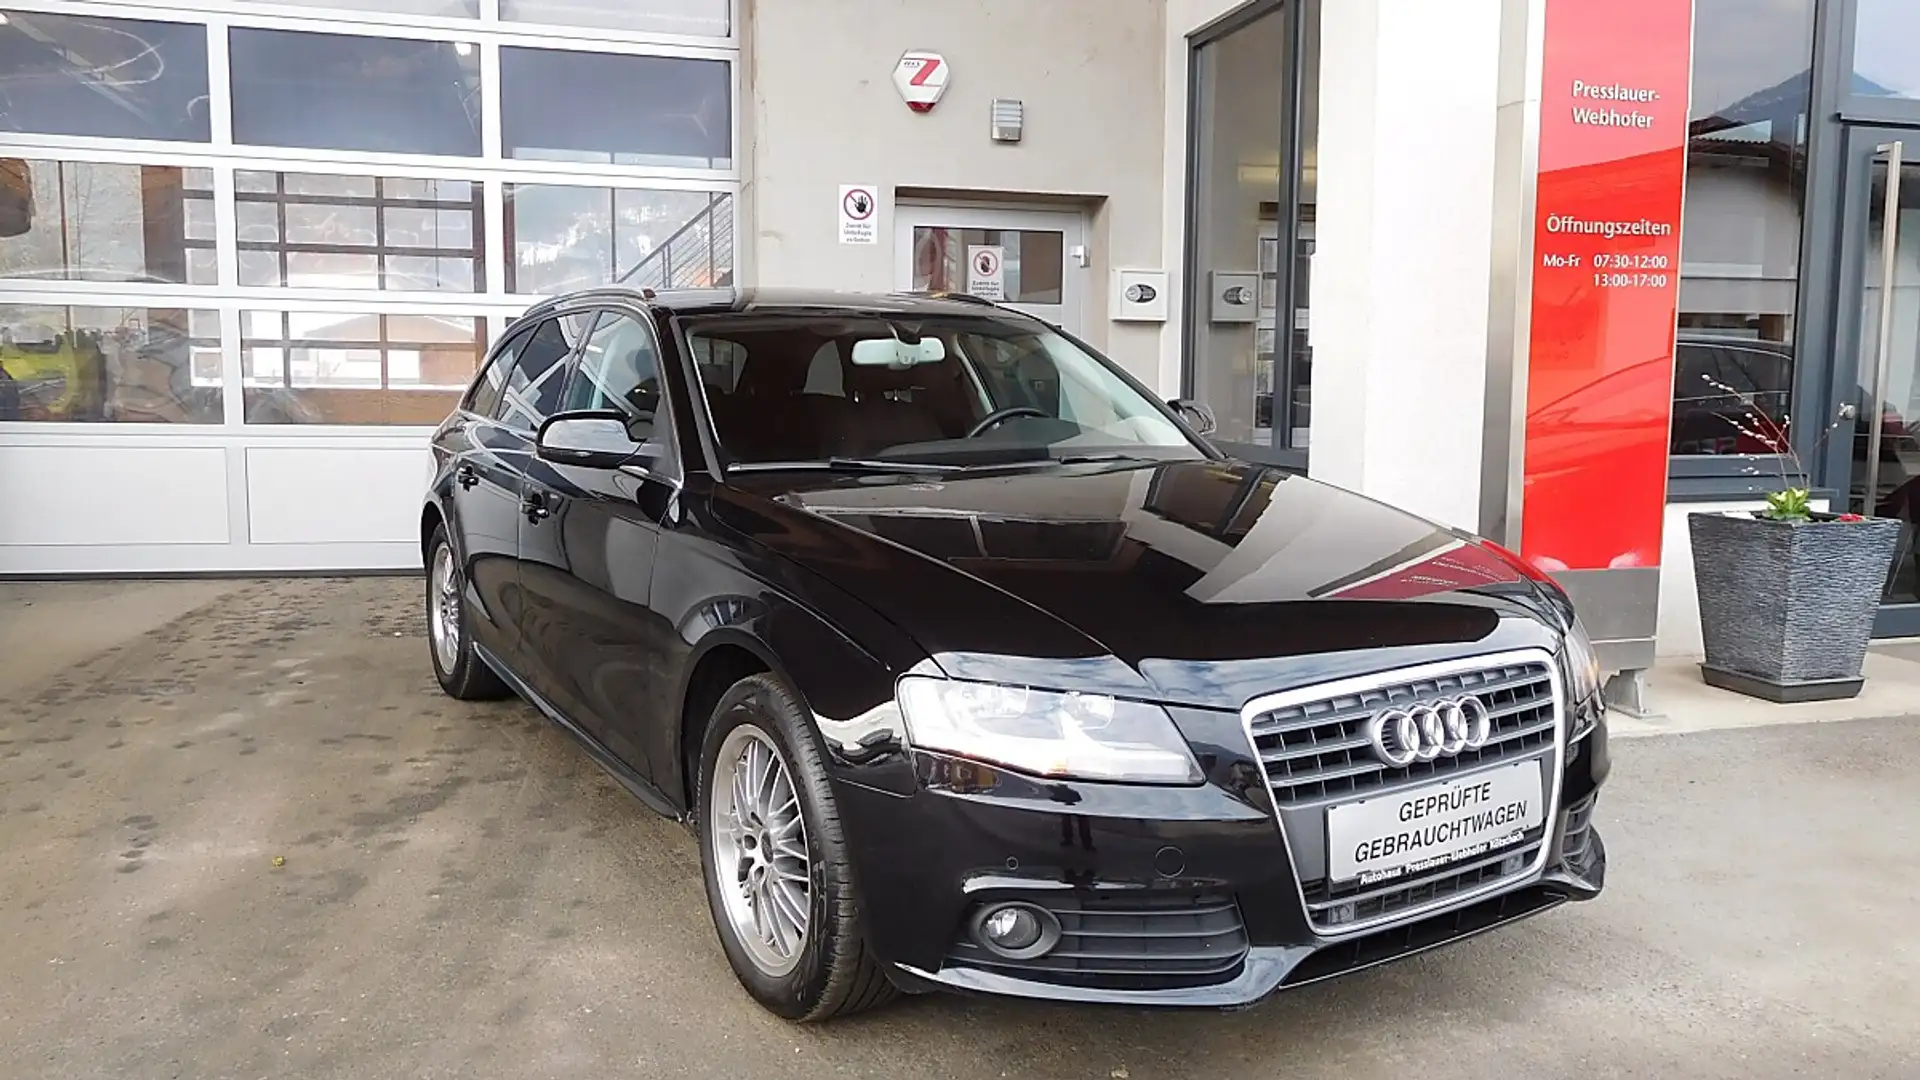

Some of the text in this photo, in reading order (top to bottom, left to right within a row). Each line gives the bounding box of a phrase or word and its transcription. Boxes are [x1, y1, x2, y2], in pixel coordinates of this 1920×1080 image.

[1572, 80, 1660, 102] Presslauer-
[1572, 107, 1654, 128] Webhofer
[1546, 213, 1671, 238] Öffnungszeiten
[1543, 254, 1668, 269] Mo-Fr 07:30-12:00
[1593, 273, 1667, 287] 13:00-17:00
[1400, 781, 1491, 821] GEPRÜFTE
[1355, 800, 1528, 863] GEBRAUCHTWAGEN
